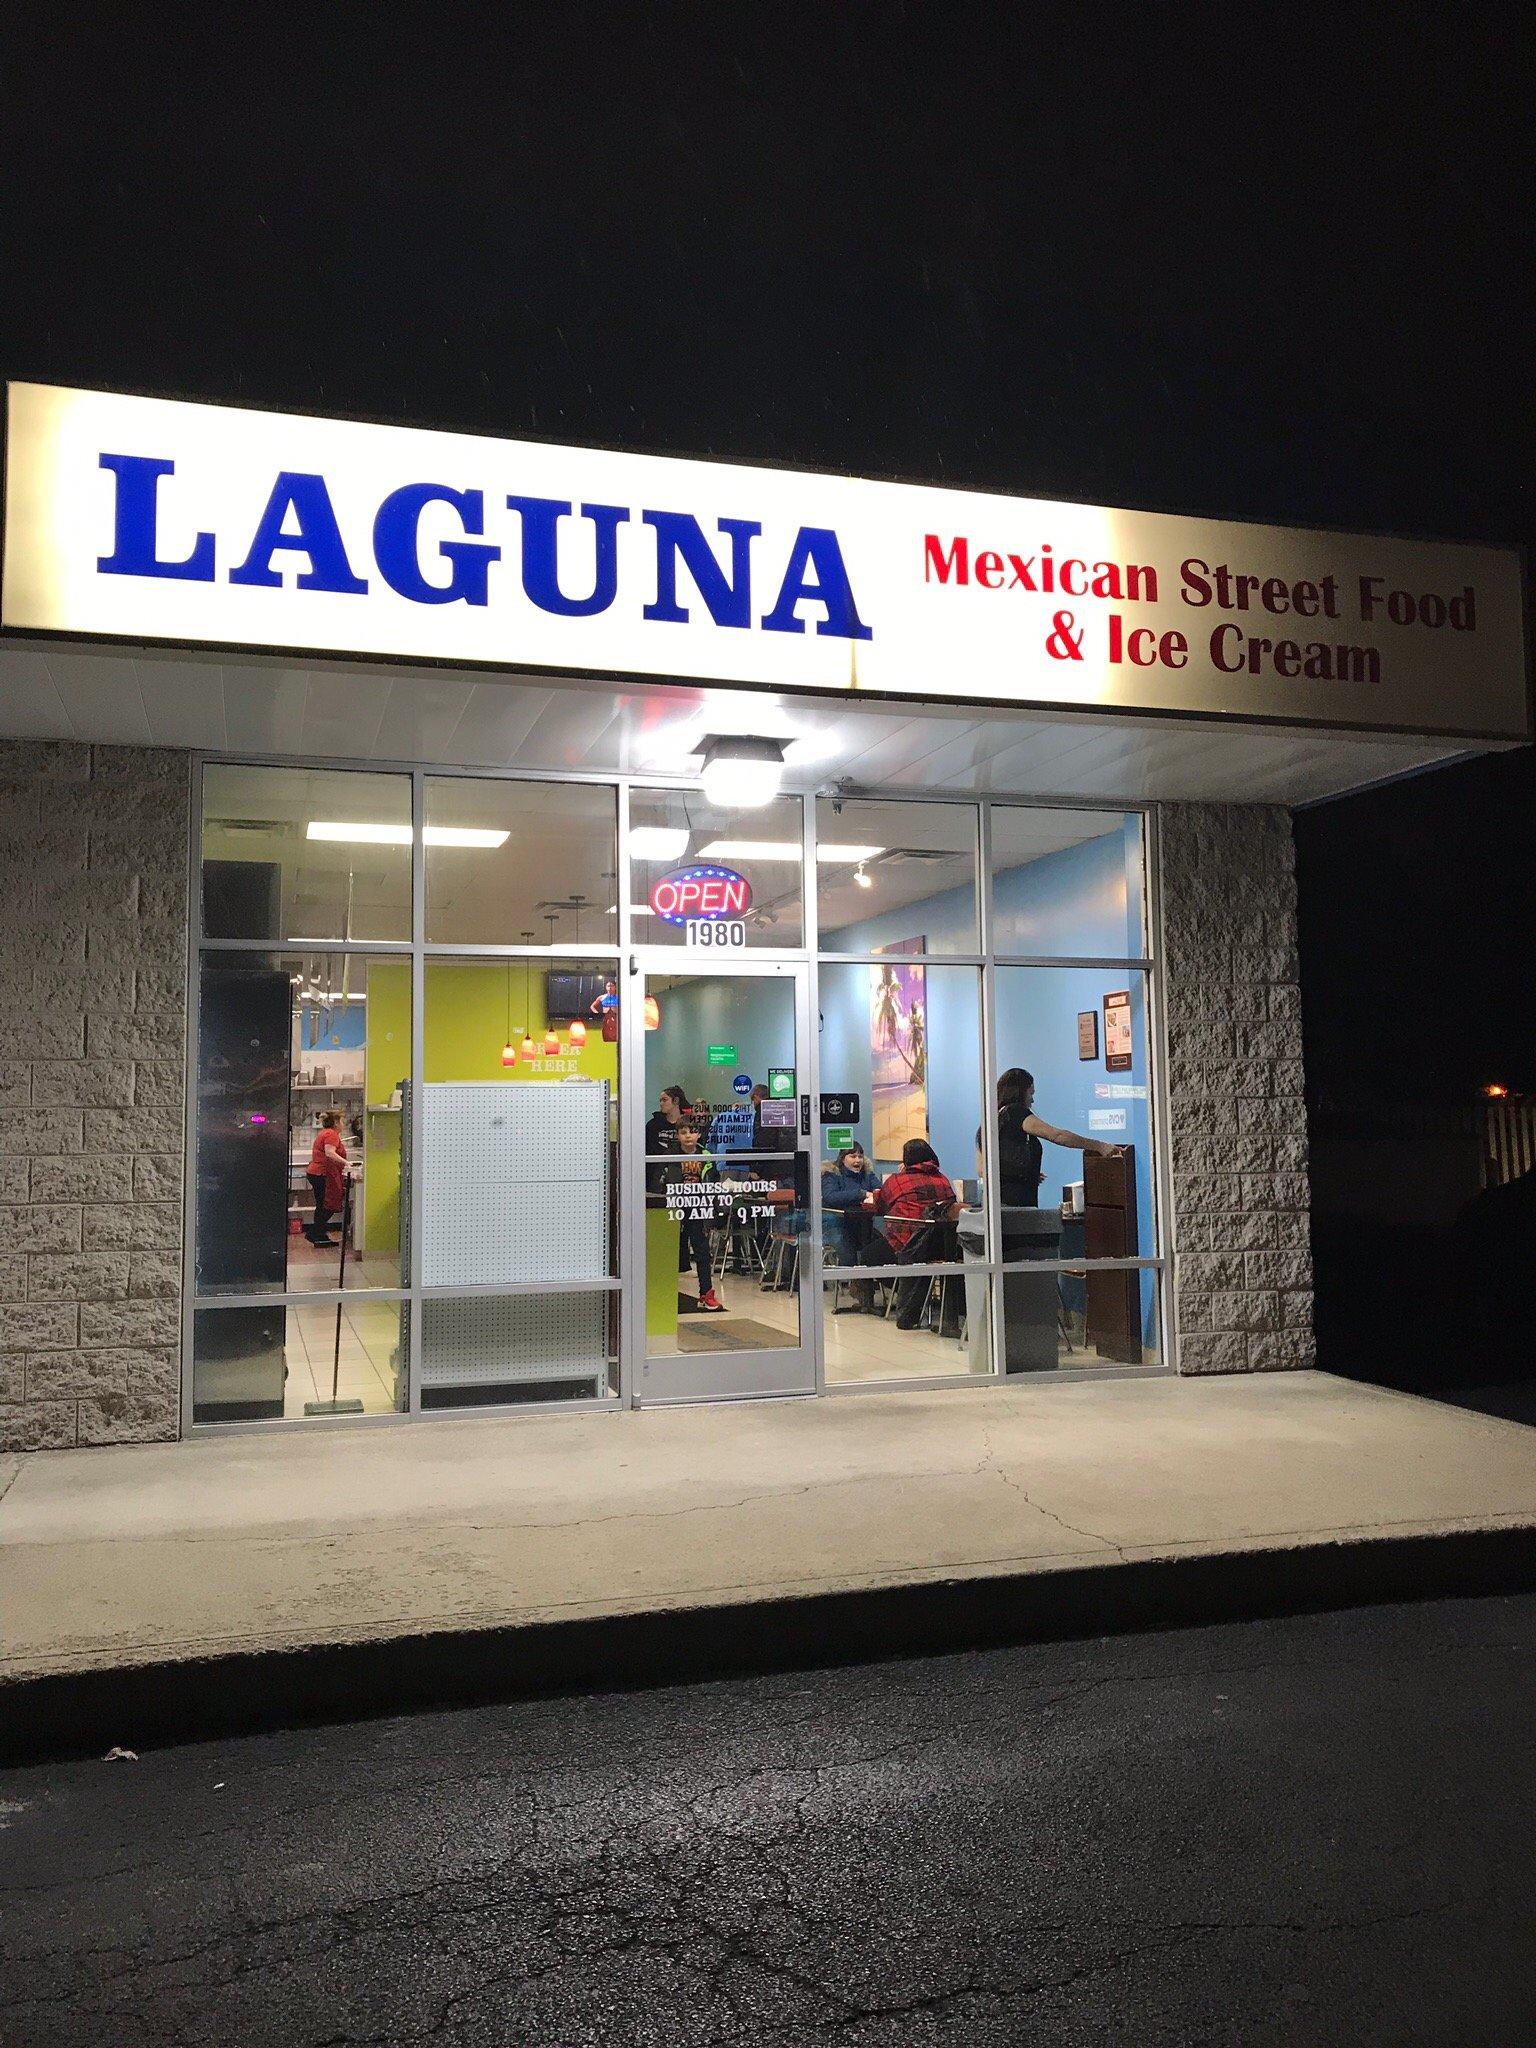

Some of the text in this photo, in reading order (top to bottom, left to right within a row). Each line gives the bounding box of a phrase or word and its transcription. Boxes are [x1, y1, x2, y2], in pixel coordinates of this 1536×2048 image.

[97, 453, 873, 641] LAGUNA
[924, 534, 1476, 632] Mexican Street Food
[1045, 610, 1381, 684] & Ice Cream
[654, 881, 745, 913] OPEN
[689, 921, 744, 947] 1980
[531, 1060, 578, 1072] HERE
[666, 1181, 778, 1195] BUSINESS HOURS
[666, 1195, 733, 1208] MONDAY TO
[668, 1210, 685, 1221] 10
[689, 1207, 714, 1220] AM
[737, 1207, 747, 1224] 9
[751, 1205, 776, 1218] PM
